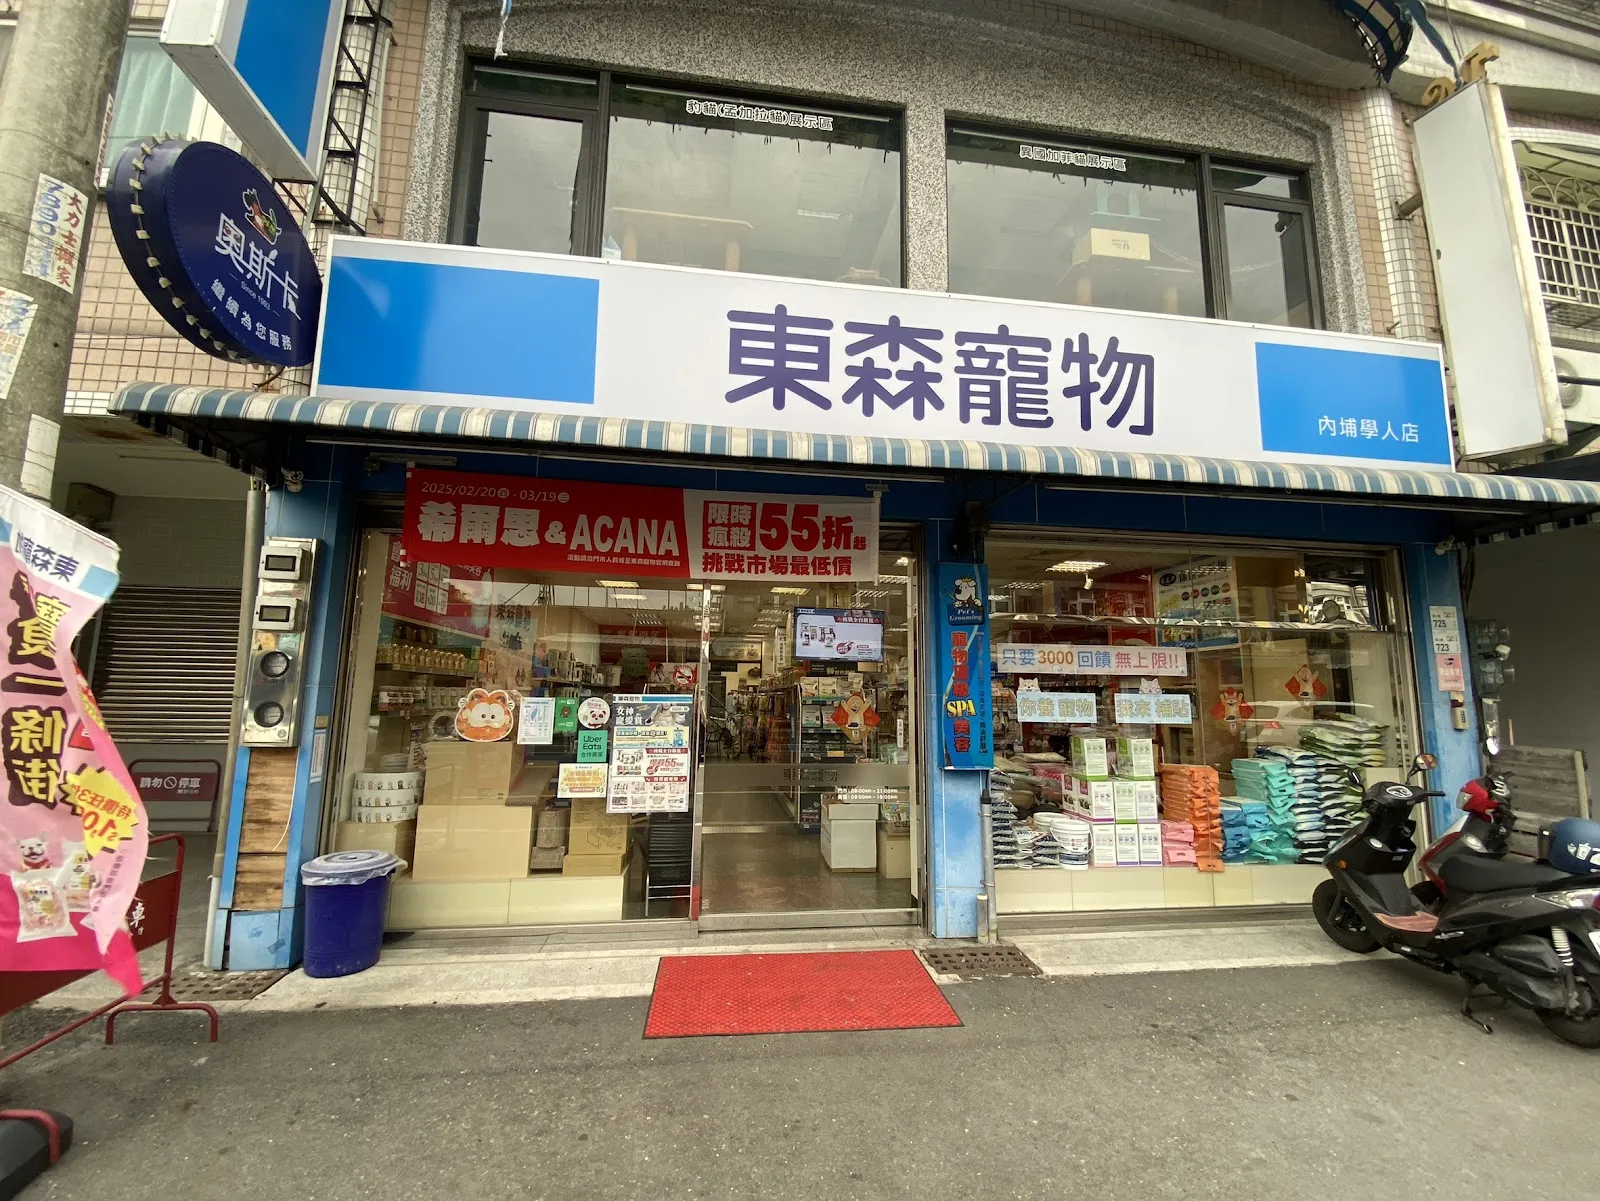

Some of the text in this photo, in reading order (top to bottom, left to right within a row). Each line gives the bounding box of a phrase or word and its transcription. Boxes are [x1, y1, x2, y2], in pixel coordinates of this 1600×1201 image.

[685, 99, 833, 132] 豹貓(孟加拉貓)展示區
[1019, 144, 1127, 172] 異國加菲貓展示區
[211, 278, 292, 350] 繼續為您服務
[724, 304, 1155, 437] 東森寵物
[1317, 414, 1420, 444] 內埔學人店
[708, 503, 752, 525] 限時
[417, 500, 541, 547] 希爾思
[569, 514, 680, 557] ACANA
[708, 526, 751, 548] 瘋殺
[702, 552, 852, 576] 挑戰市場最低價
[1433, 619, 1447, 628] 725
[1002, 648, 1034, 666] 只要
[1038, 650, 1074, 665] 3000
[1077, 651, 1111, 669] 回饋
[1436, 643, 1450, 652] 723
[947, 699, 976, 718] SPA
[1058, 698, 1094, 718] 寵物
[583, 735, 602, 743] Uber
[952, 719, 971, 753] 美容
[140, 776, 202, 789] 請勿 停車
